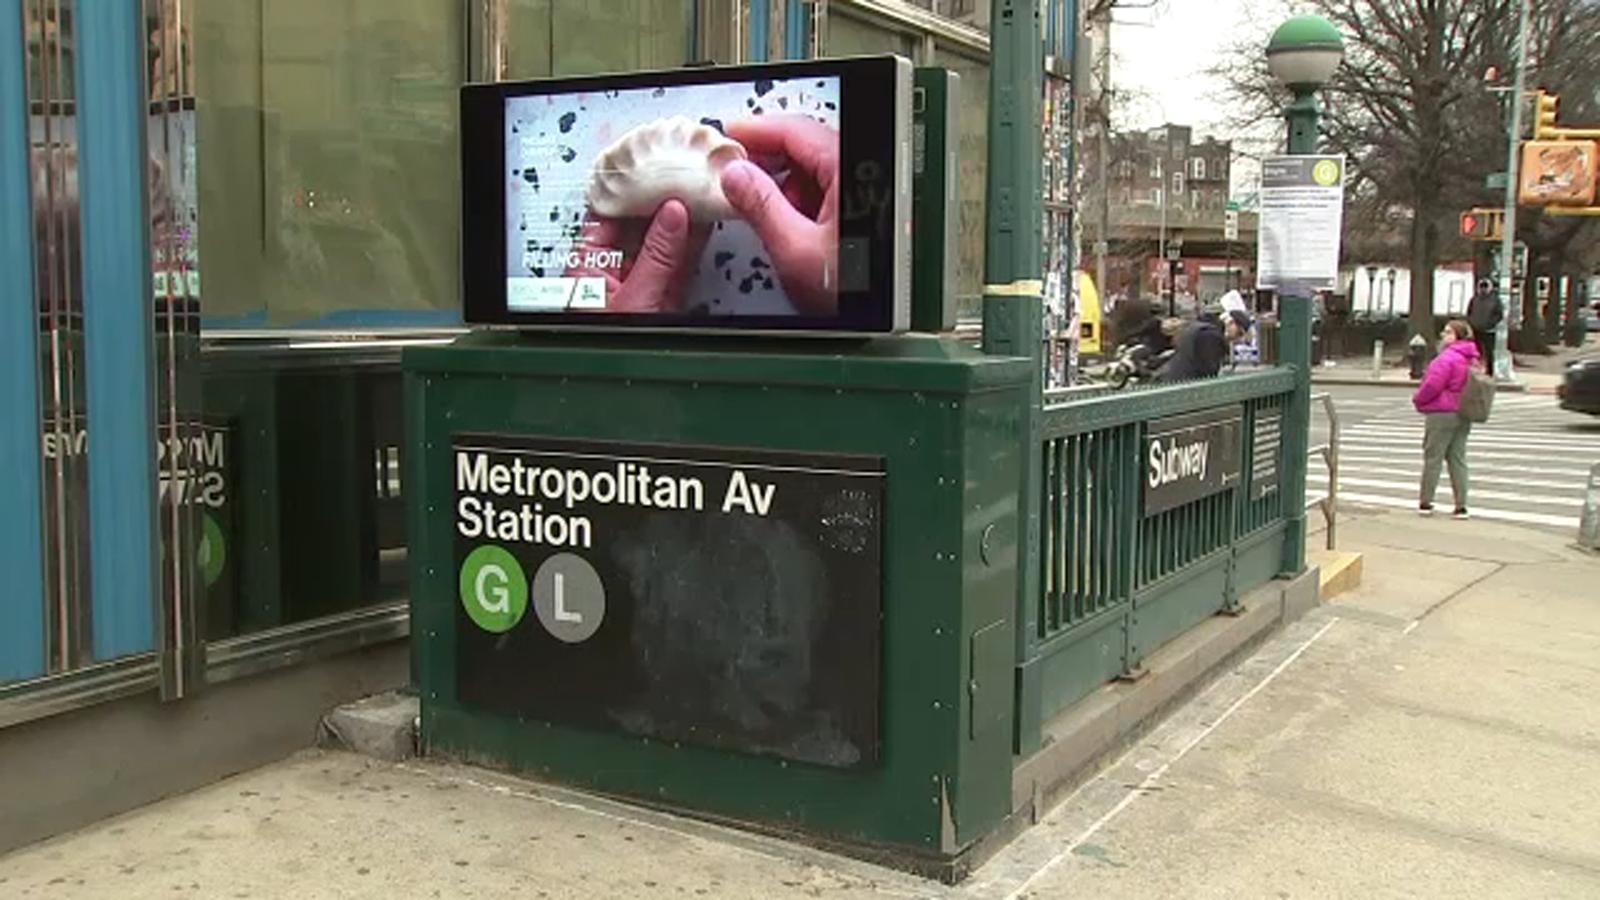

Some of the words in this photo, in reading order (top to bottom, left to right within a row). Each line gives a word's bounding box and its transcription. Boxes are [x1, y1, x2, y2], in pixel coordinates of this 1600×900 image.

[1319, 164, 1332, 180] G
[584, 251, 624, 269] HOT!
[457, 452, 704, 510] Metropolitan
[722, 470, 776, 516] Av
[1149, 437, 1209, 488] Subway
[457, 496, 592, 548] Station
[475, 564, 510, 614] G
[553, 573, 583, 623] L
